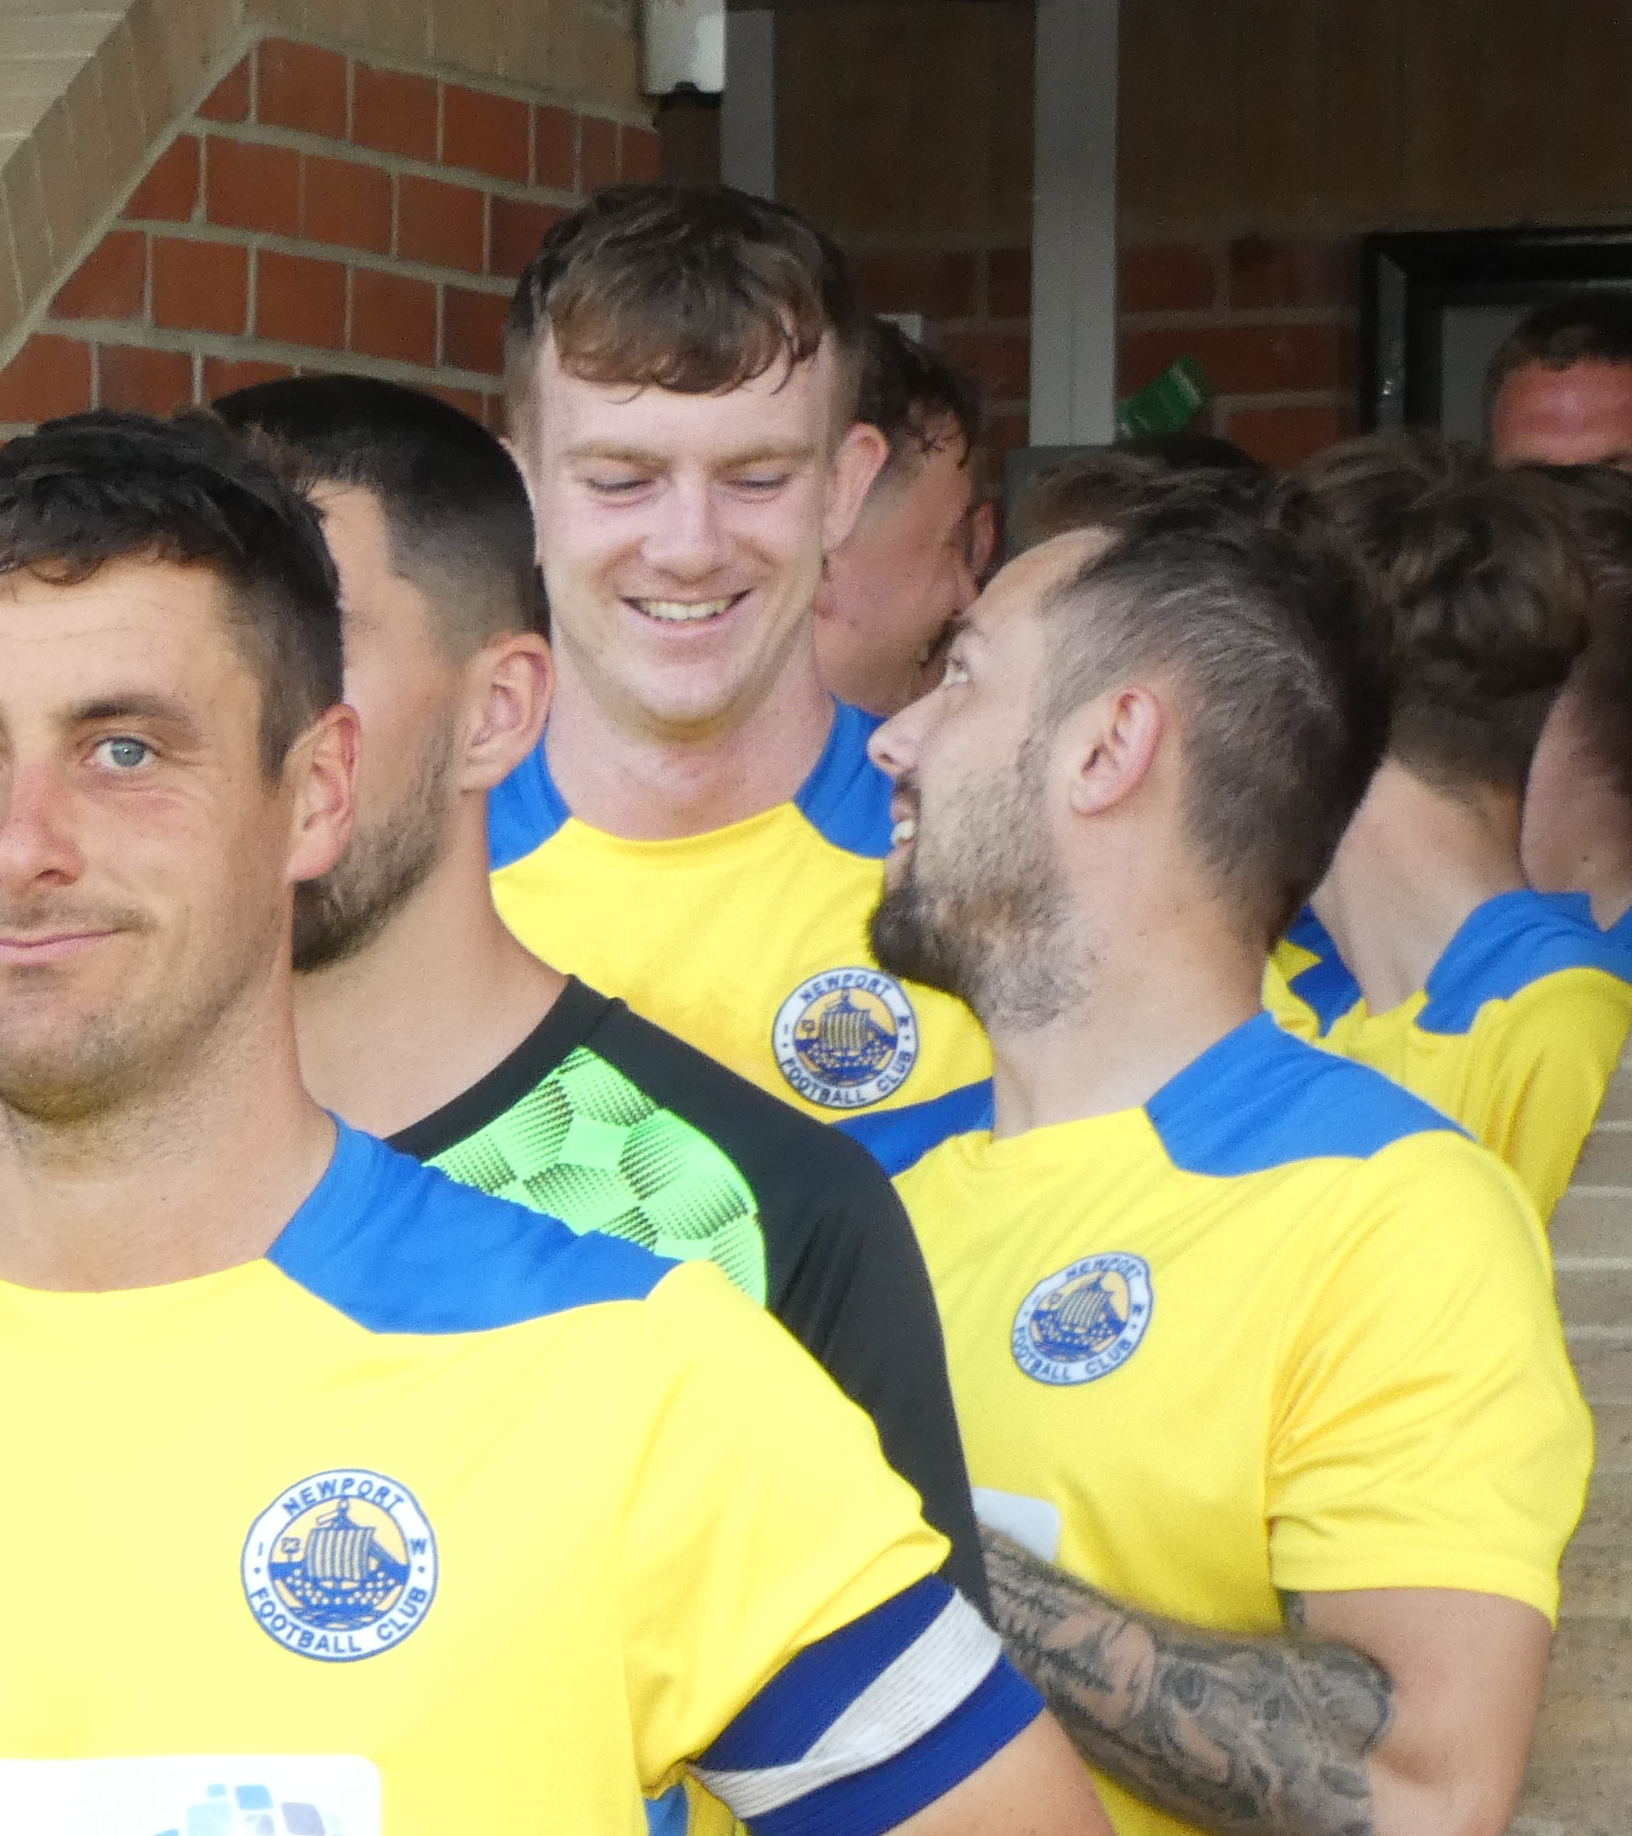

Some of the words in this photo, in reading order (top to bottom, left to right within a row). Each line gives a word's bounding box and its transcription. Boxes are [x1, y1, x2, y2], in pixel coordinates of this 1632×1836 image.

[799, 973, 893, 1003] NEWPORT
[781, 1057, 868, 1106] FOOTBALL
[876, 1050, 914, 1093] CLUB
[1066, 1256, 1143, 1283] NEWPORT
[1012, 1324, 1072, 1381] FOOTBALL
[1085, 1337, 1133, 1376] CLUB
[281, 1477, 406, 1518] NEWPORT
[247, 1585, 363, 1654] FOOTBALL
[375, 1585, 429, 1642] CLUB
